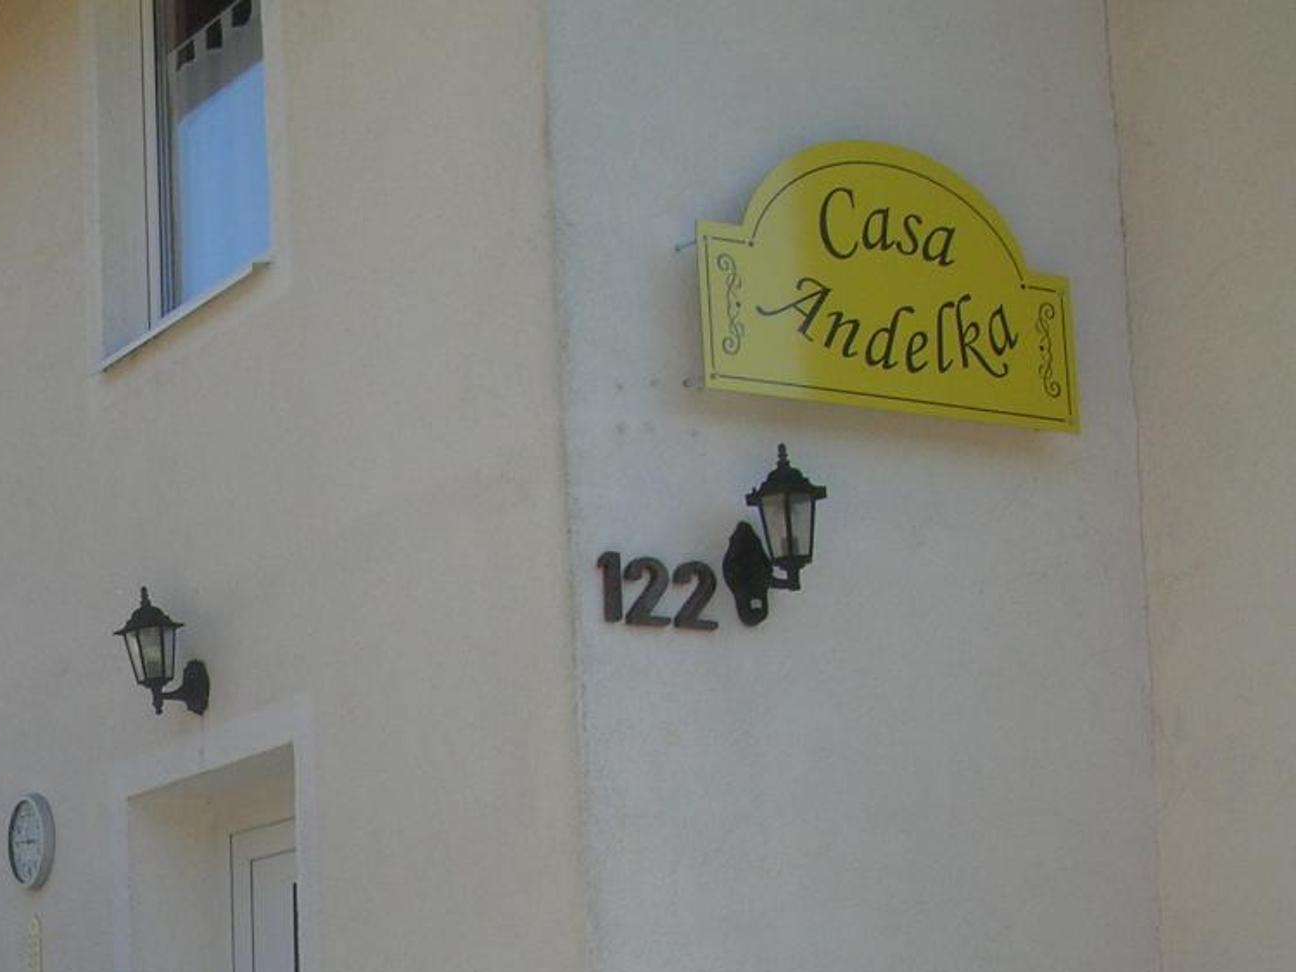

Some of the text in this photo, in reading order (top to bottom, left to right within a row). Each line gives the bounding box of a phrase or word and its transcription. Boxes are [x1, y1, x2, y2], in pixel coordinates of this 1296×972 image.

[818, 187, 957, 267] Casa
[756, 276, 1020, 379] Andelka
[596, 551, 719, 630] 122
